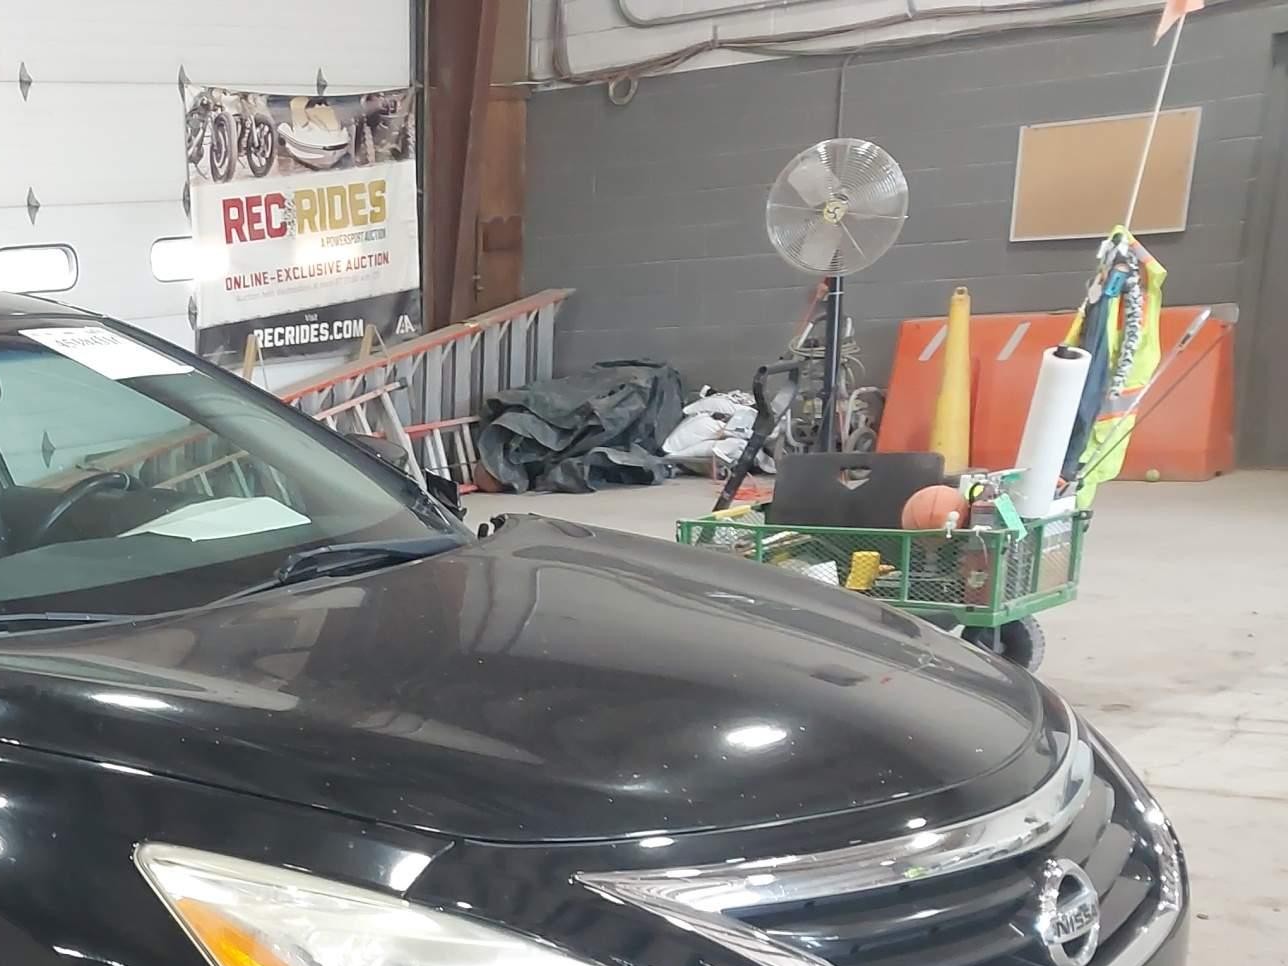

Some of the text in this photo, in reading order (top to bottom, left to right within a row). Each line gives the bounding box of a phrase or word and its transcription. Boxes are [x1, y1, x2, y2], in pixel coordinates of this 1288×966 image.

[222, 180, 387, 244] REC RIDES
[225, 260, 342, 291] ONLINE-EXCLUSIVE
[346, 251, 389, 272] AUCTION
[254, 319, 364, 348] RECRIDES.COM
[1055, 903, 1098, 937] NISSA
